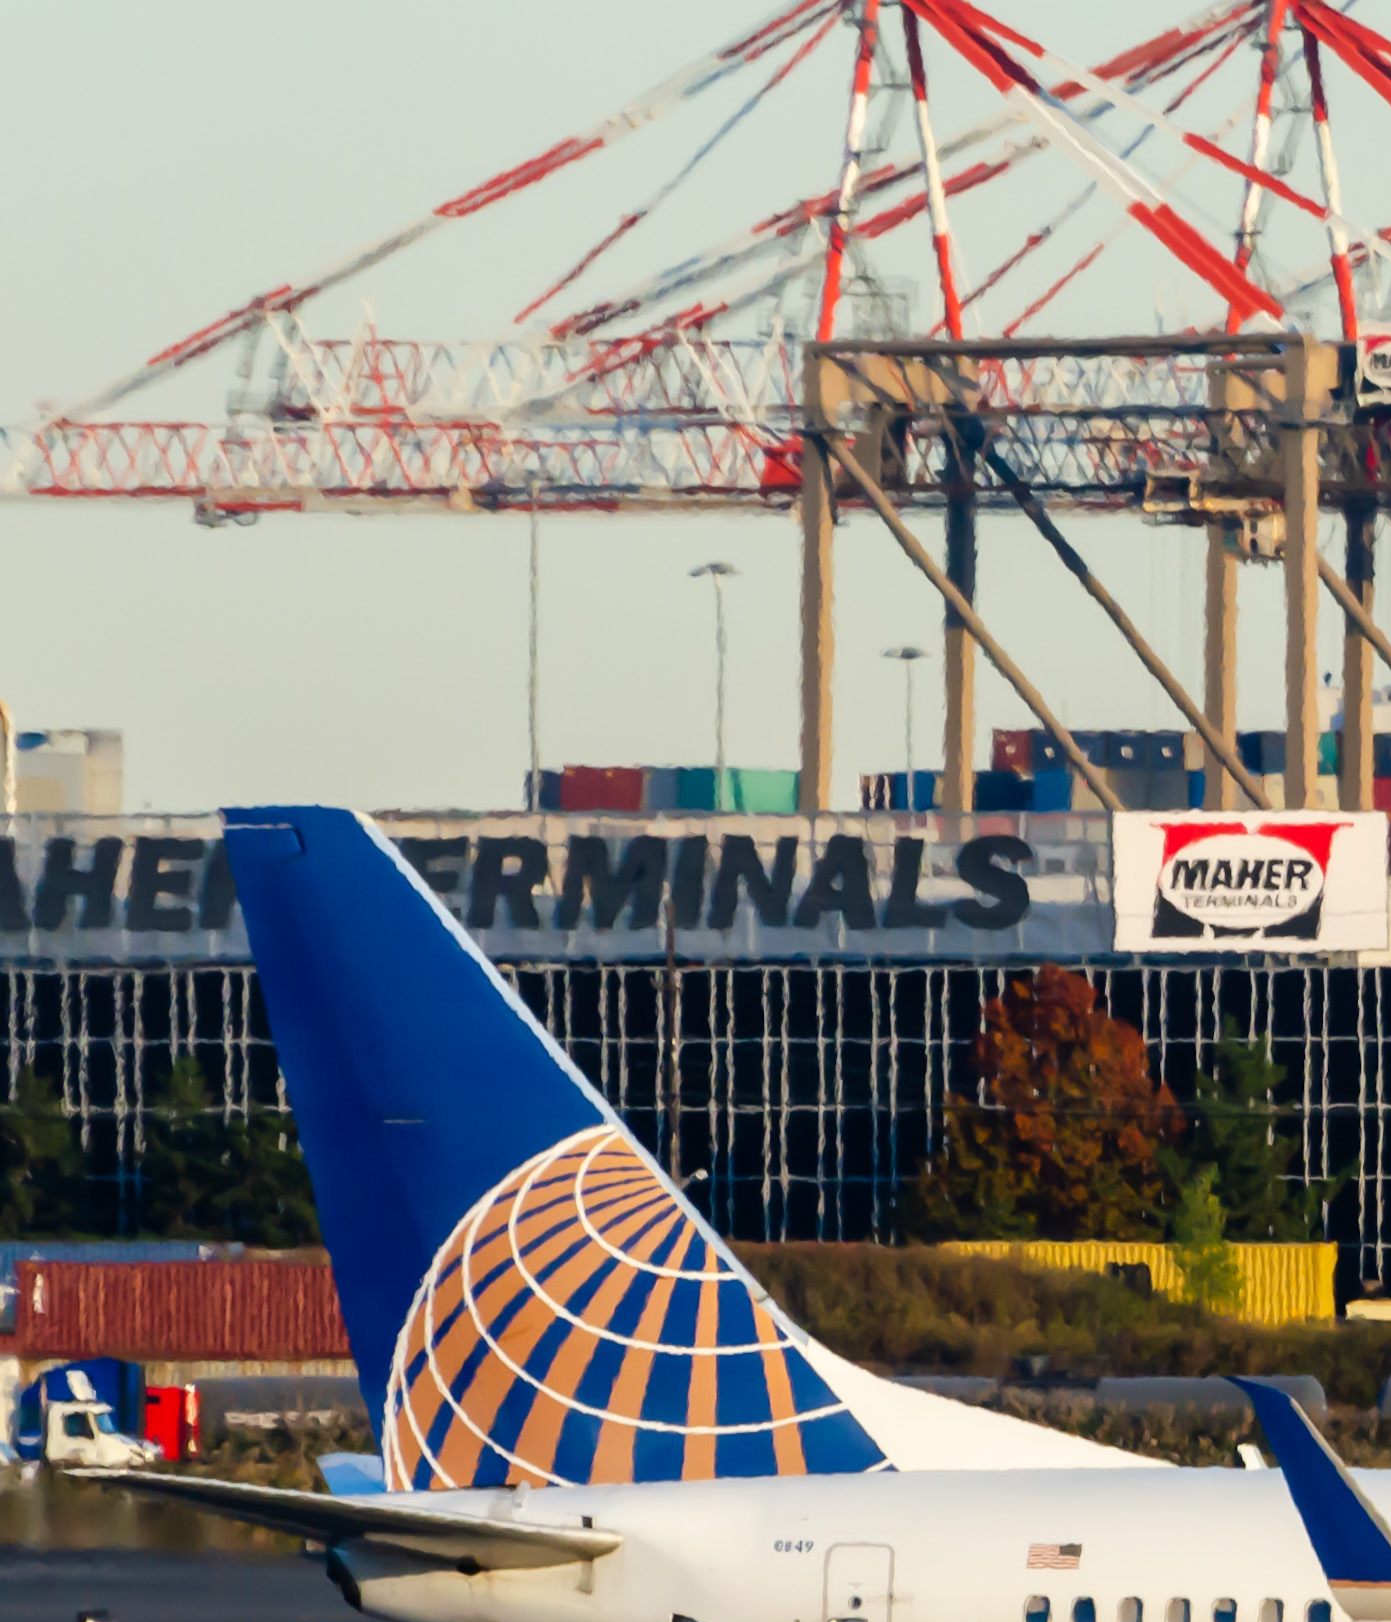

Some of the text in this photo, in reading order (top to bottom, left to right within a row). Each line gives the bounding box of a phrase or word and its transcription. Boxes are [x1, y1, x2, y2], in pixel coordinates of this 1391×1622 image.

[1170, 859, 1314, 890] MAHER
[1182, 893, 1297, 909] TERMINALS
[773, 1540, 814, 1553] 0849
